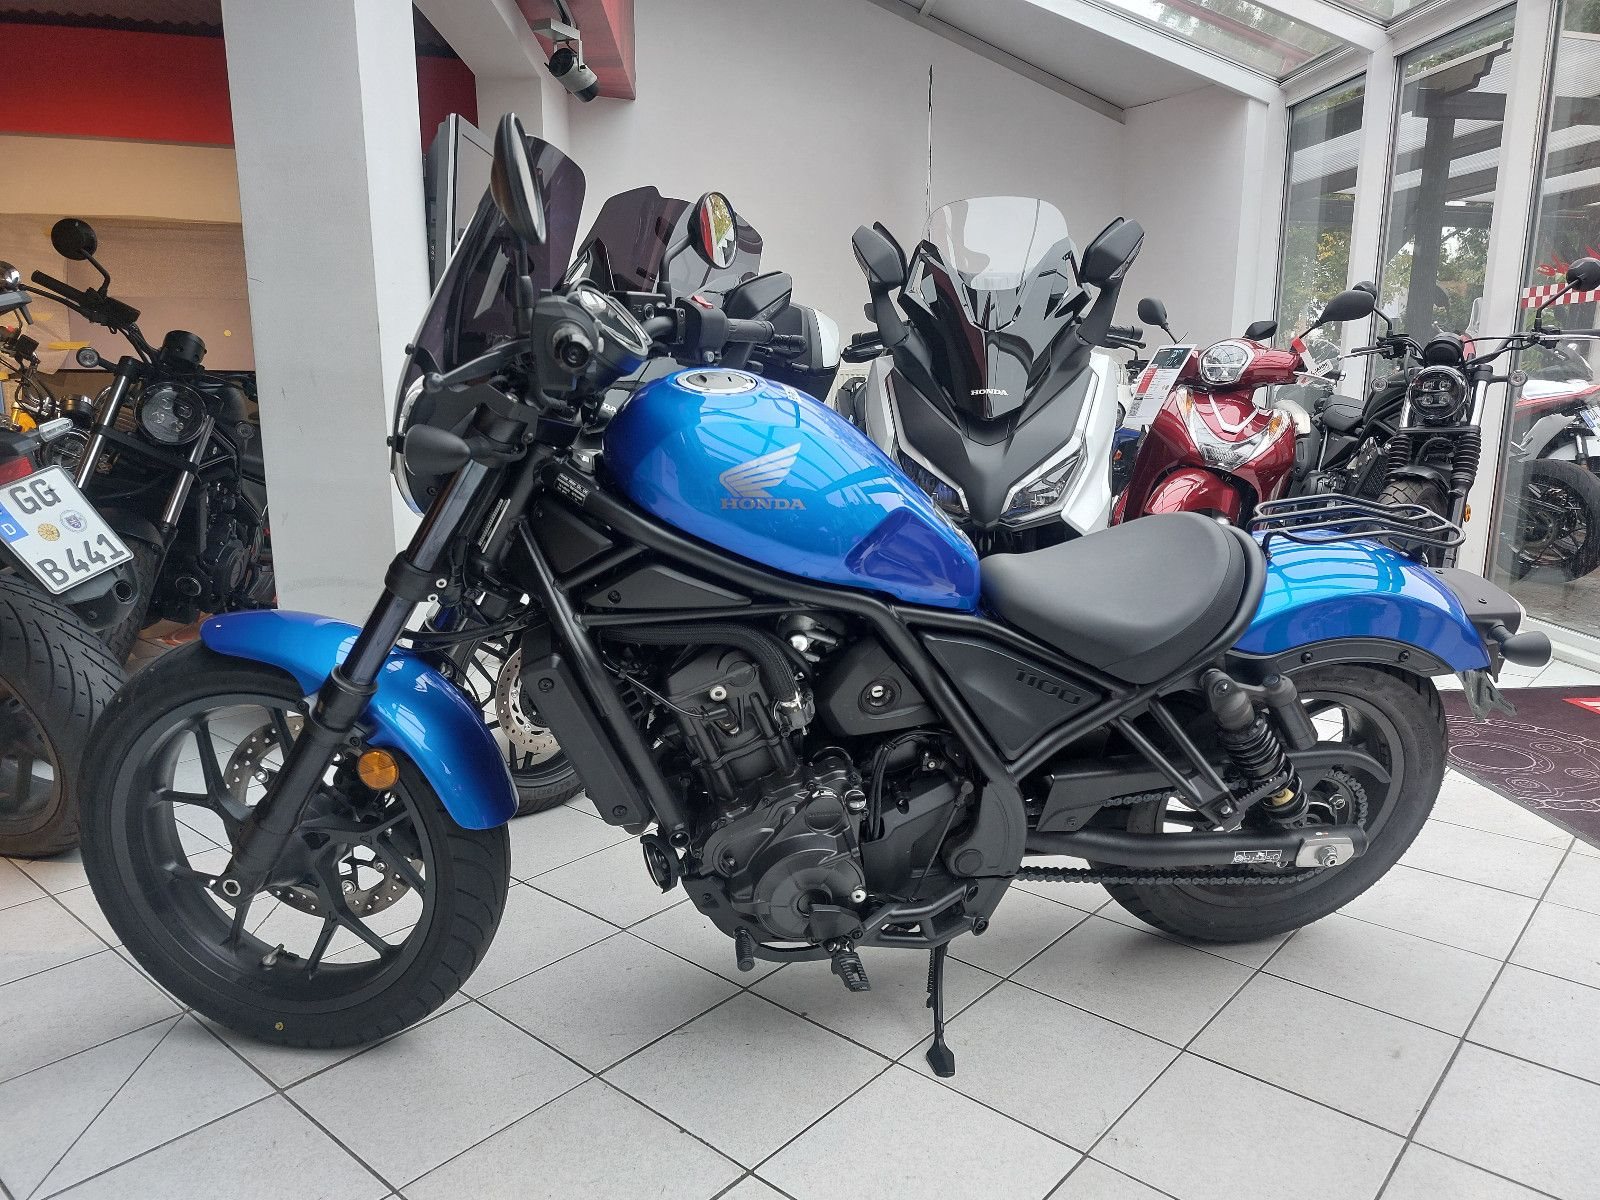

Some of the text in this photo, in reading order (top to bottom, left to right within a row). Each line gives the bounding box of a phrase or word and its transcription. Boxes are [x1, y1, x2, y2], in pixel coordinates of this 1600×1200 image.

[970, 388, 1009, 396] HONDA
[9, 478, 62, 515] GG
[720, 497, 808, 511] HONDA
[2, 523, 17, 536] D
[1015, 667, 1082, 706] 1100
